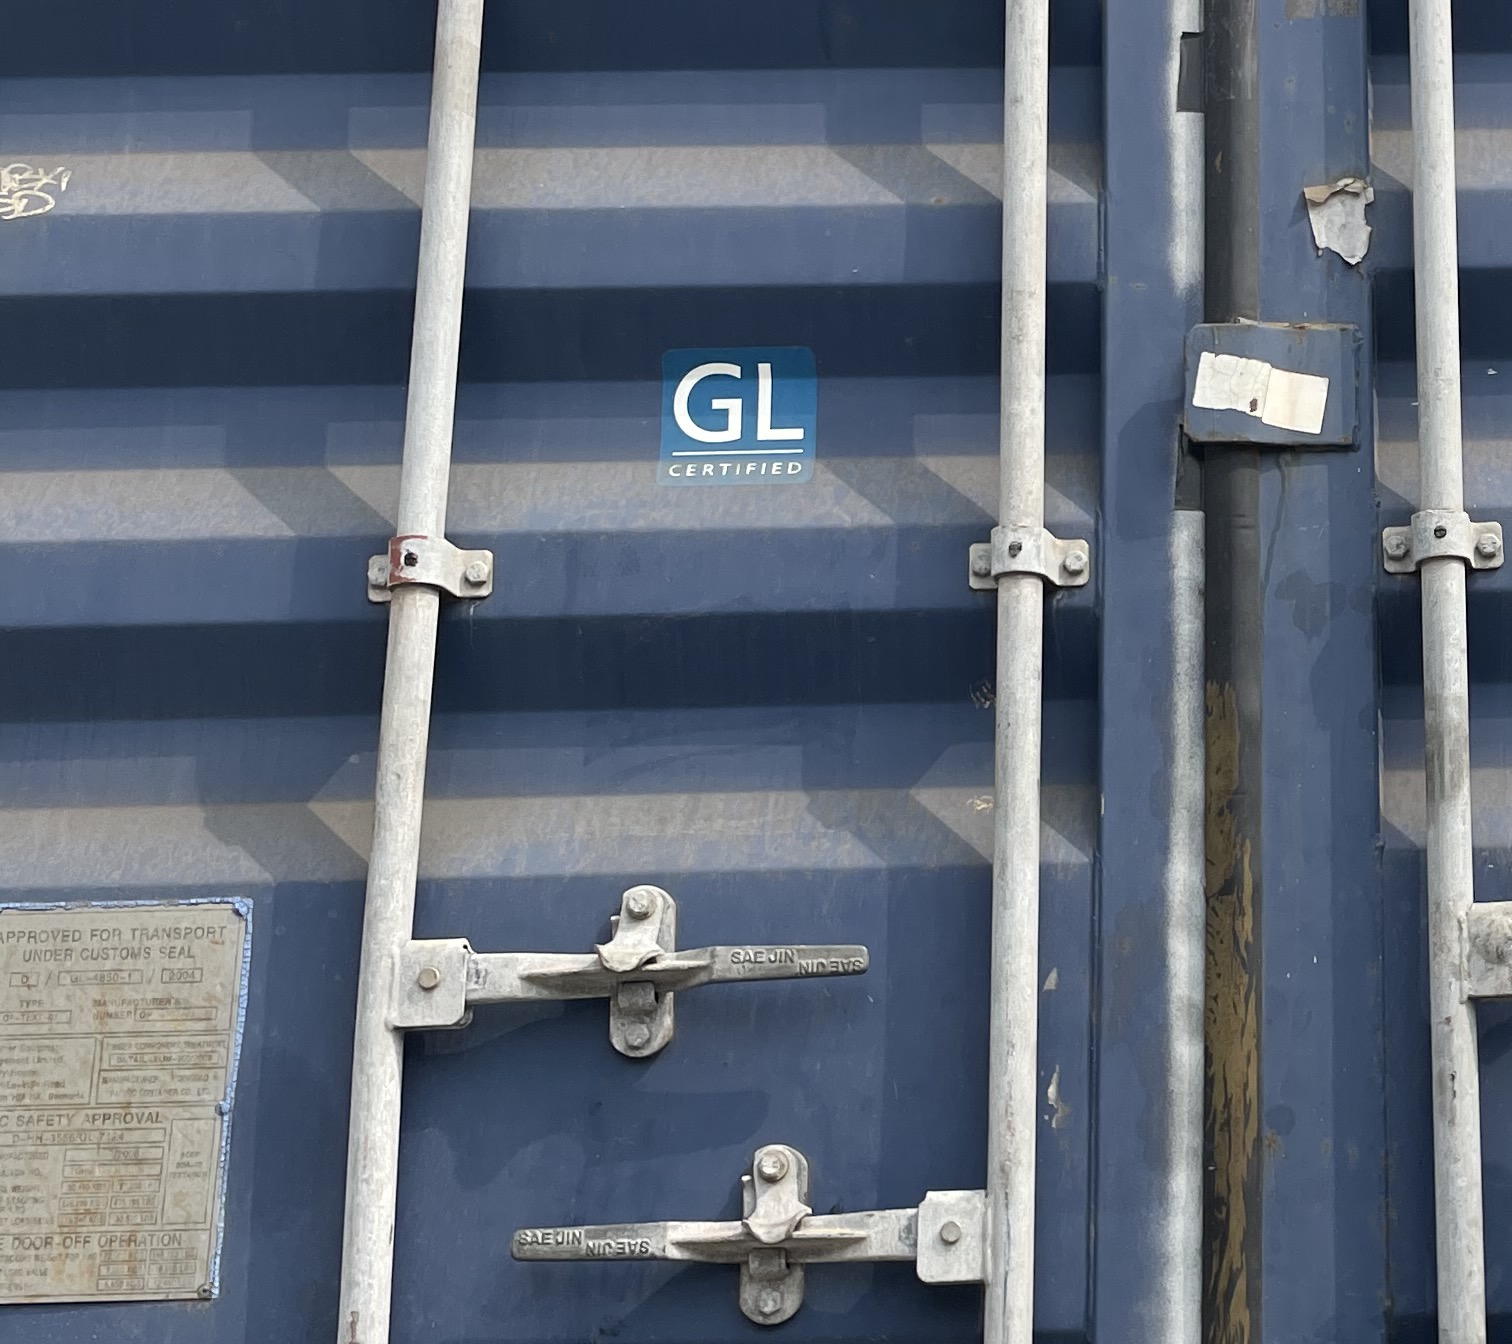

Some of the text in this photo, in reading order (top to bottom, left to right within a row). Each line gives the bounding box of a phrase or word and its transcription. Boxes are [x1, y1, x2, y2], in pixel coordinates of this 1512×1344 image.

[673, 361, 805, 443] GL
[668, 461, 802, 477] CERTIFIED
[90, 928, 122, 943] FOR
[130, 925, 228, 942] TRANSPORT
[22, 945, 196, 963] UNDER CUSTOMS SEAL
[731, 950, 766, 965] SAE
[16, 1112, 75, 1127] SAFETY
[84, 1111, 163, 1126] APPROVAL
[11, 1235, 92, 1251] DOOR-OFF
[98, 1233, 183, 1249] OPERATION
[519, 1231, 554, 1246] SAE
